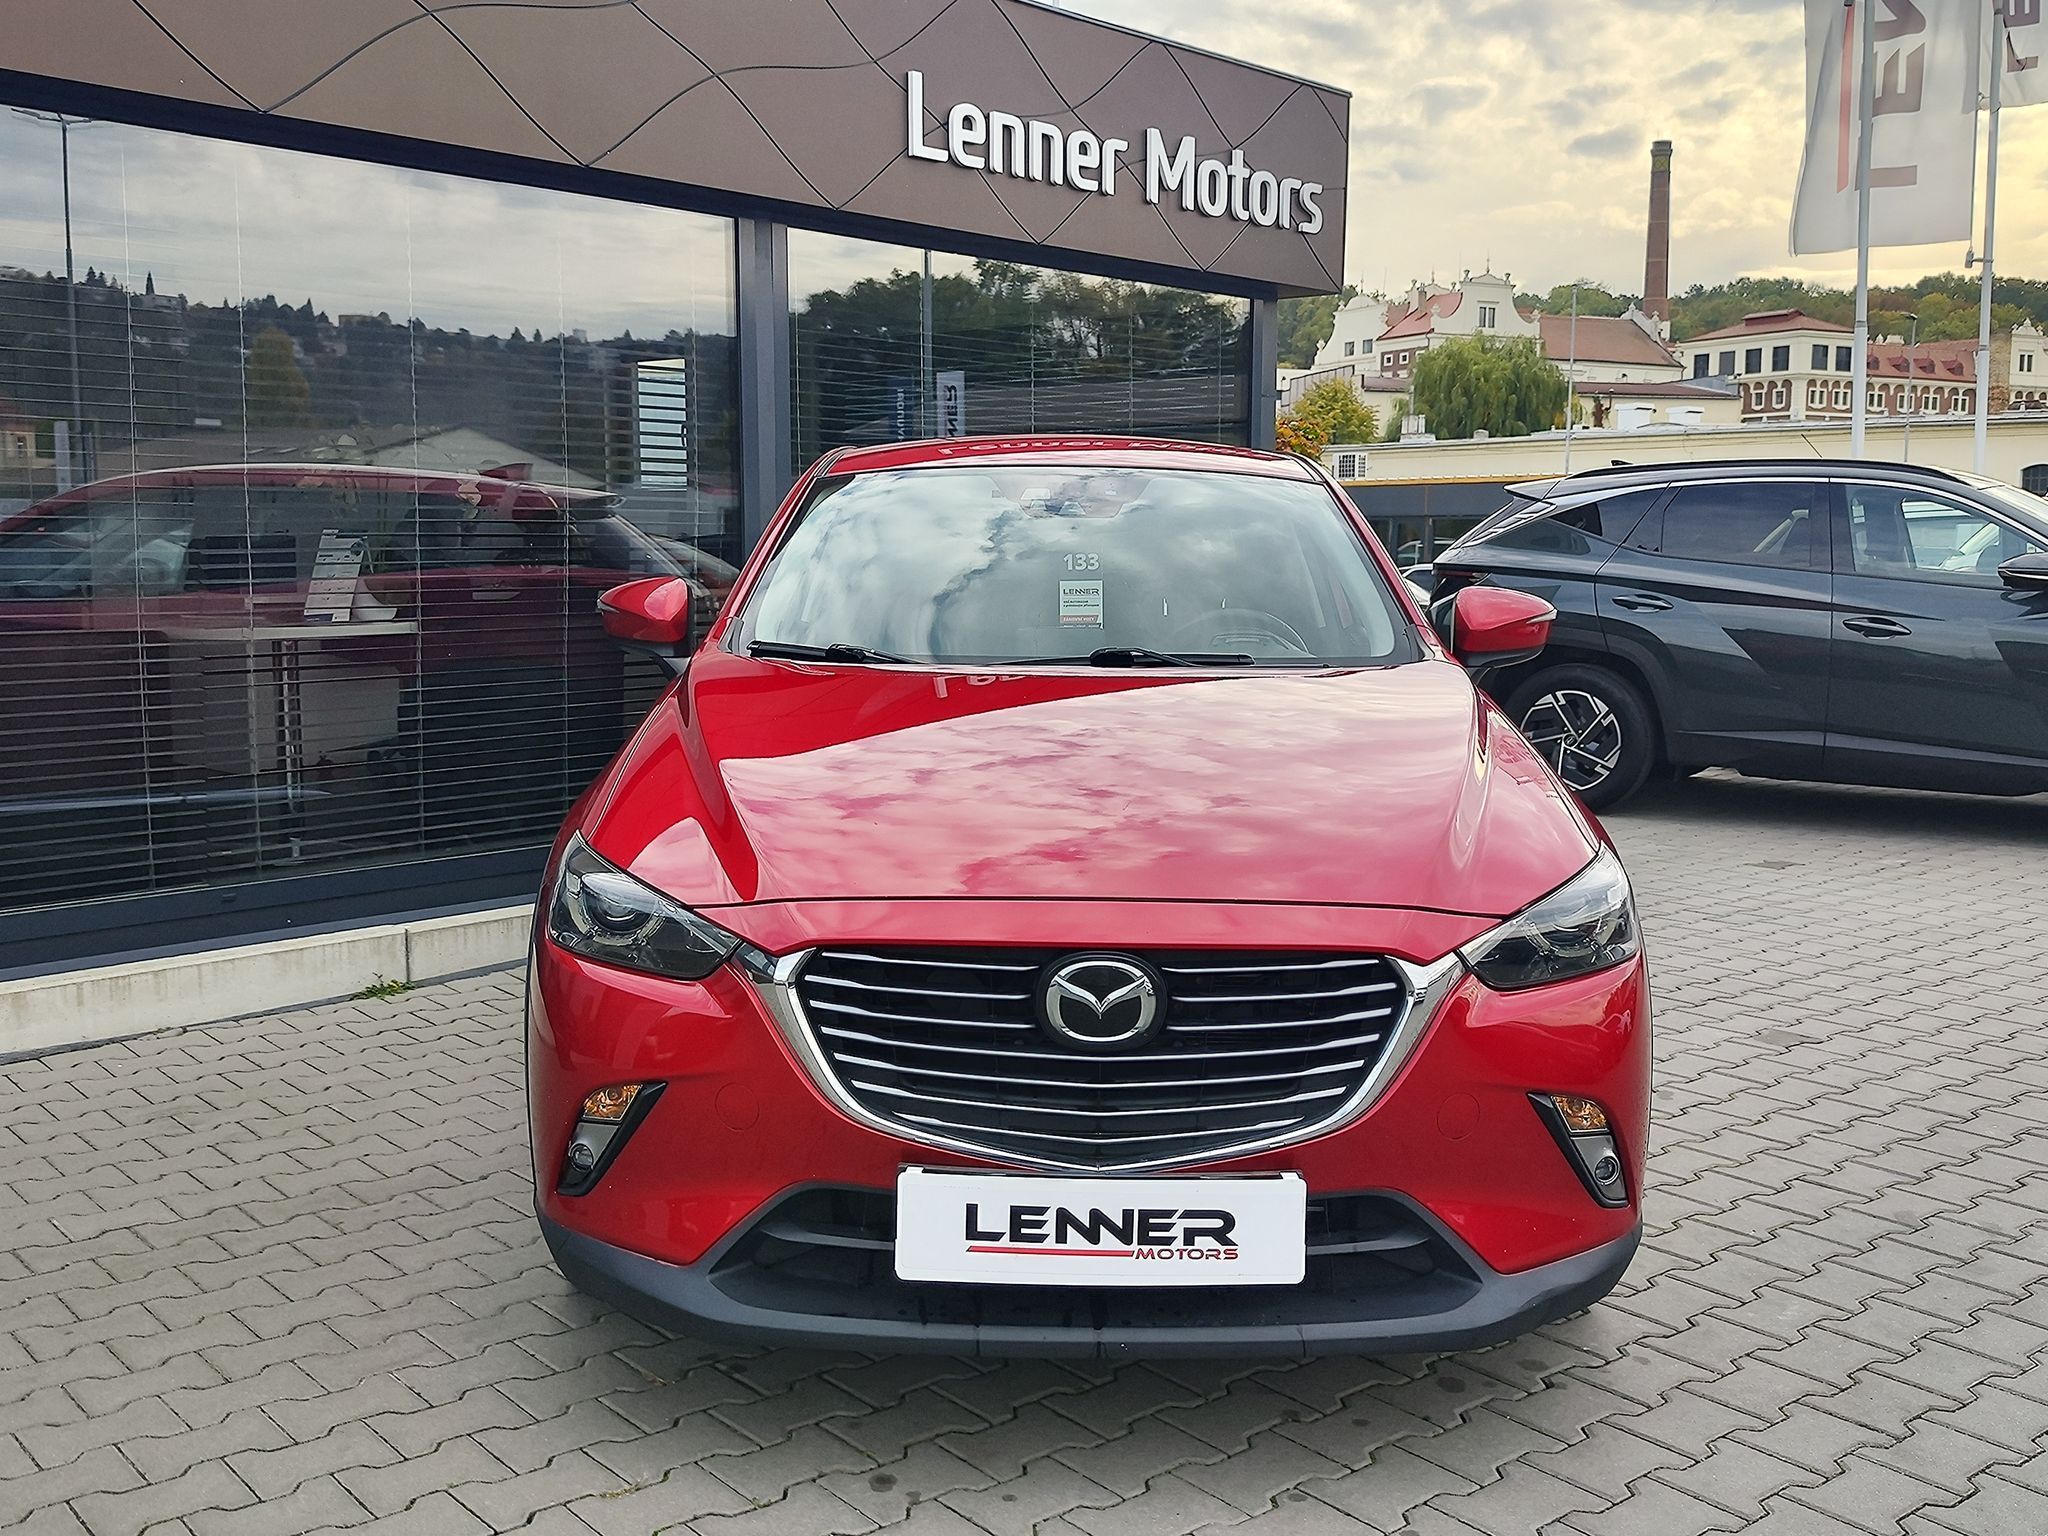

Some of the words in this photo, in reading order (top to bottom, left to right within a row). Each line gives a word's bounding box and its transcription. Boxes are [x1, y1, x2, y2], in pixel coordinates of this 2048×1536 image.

[906, 70, 1129, 196] Lenner
[1144, 127, 1324, 235] Motors
[1063, 553, 1100, 571] 133
[1063, 588, 1100, 596] LENNER
[965, 1203, 1239, 1247] LENNER
[1134, 1248, 1239, 1261] MOTORS
